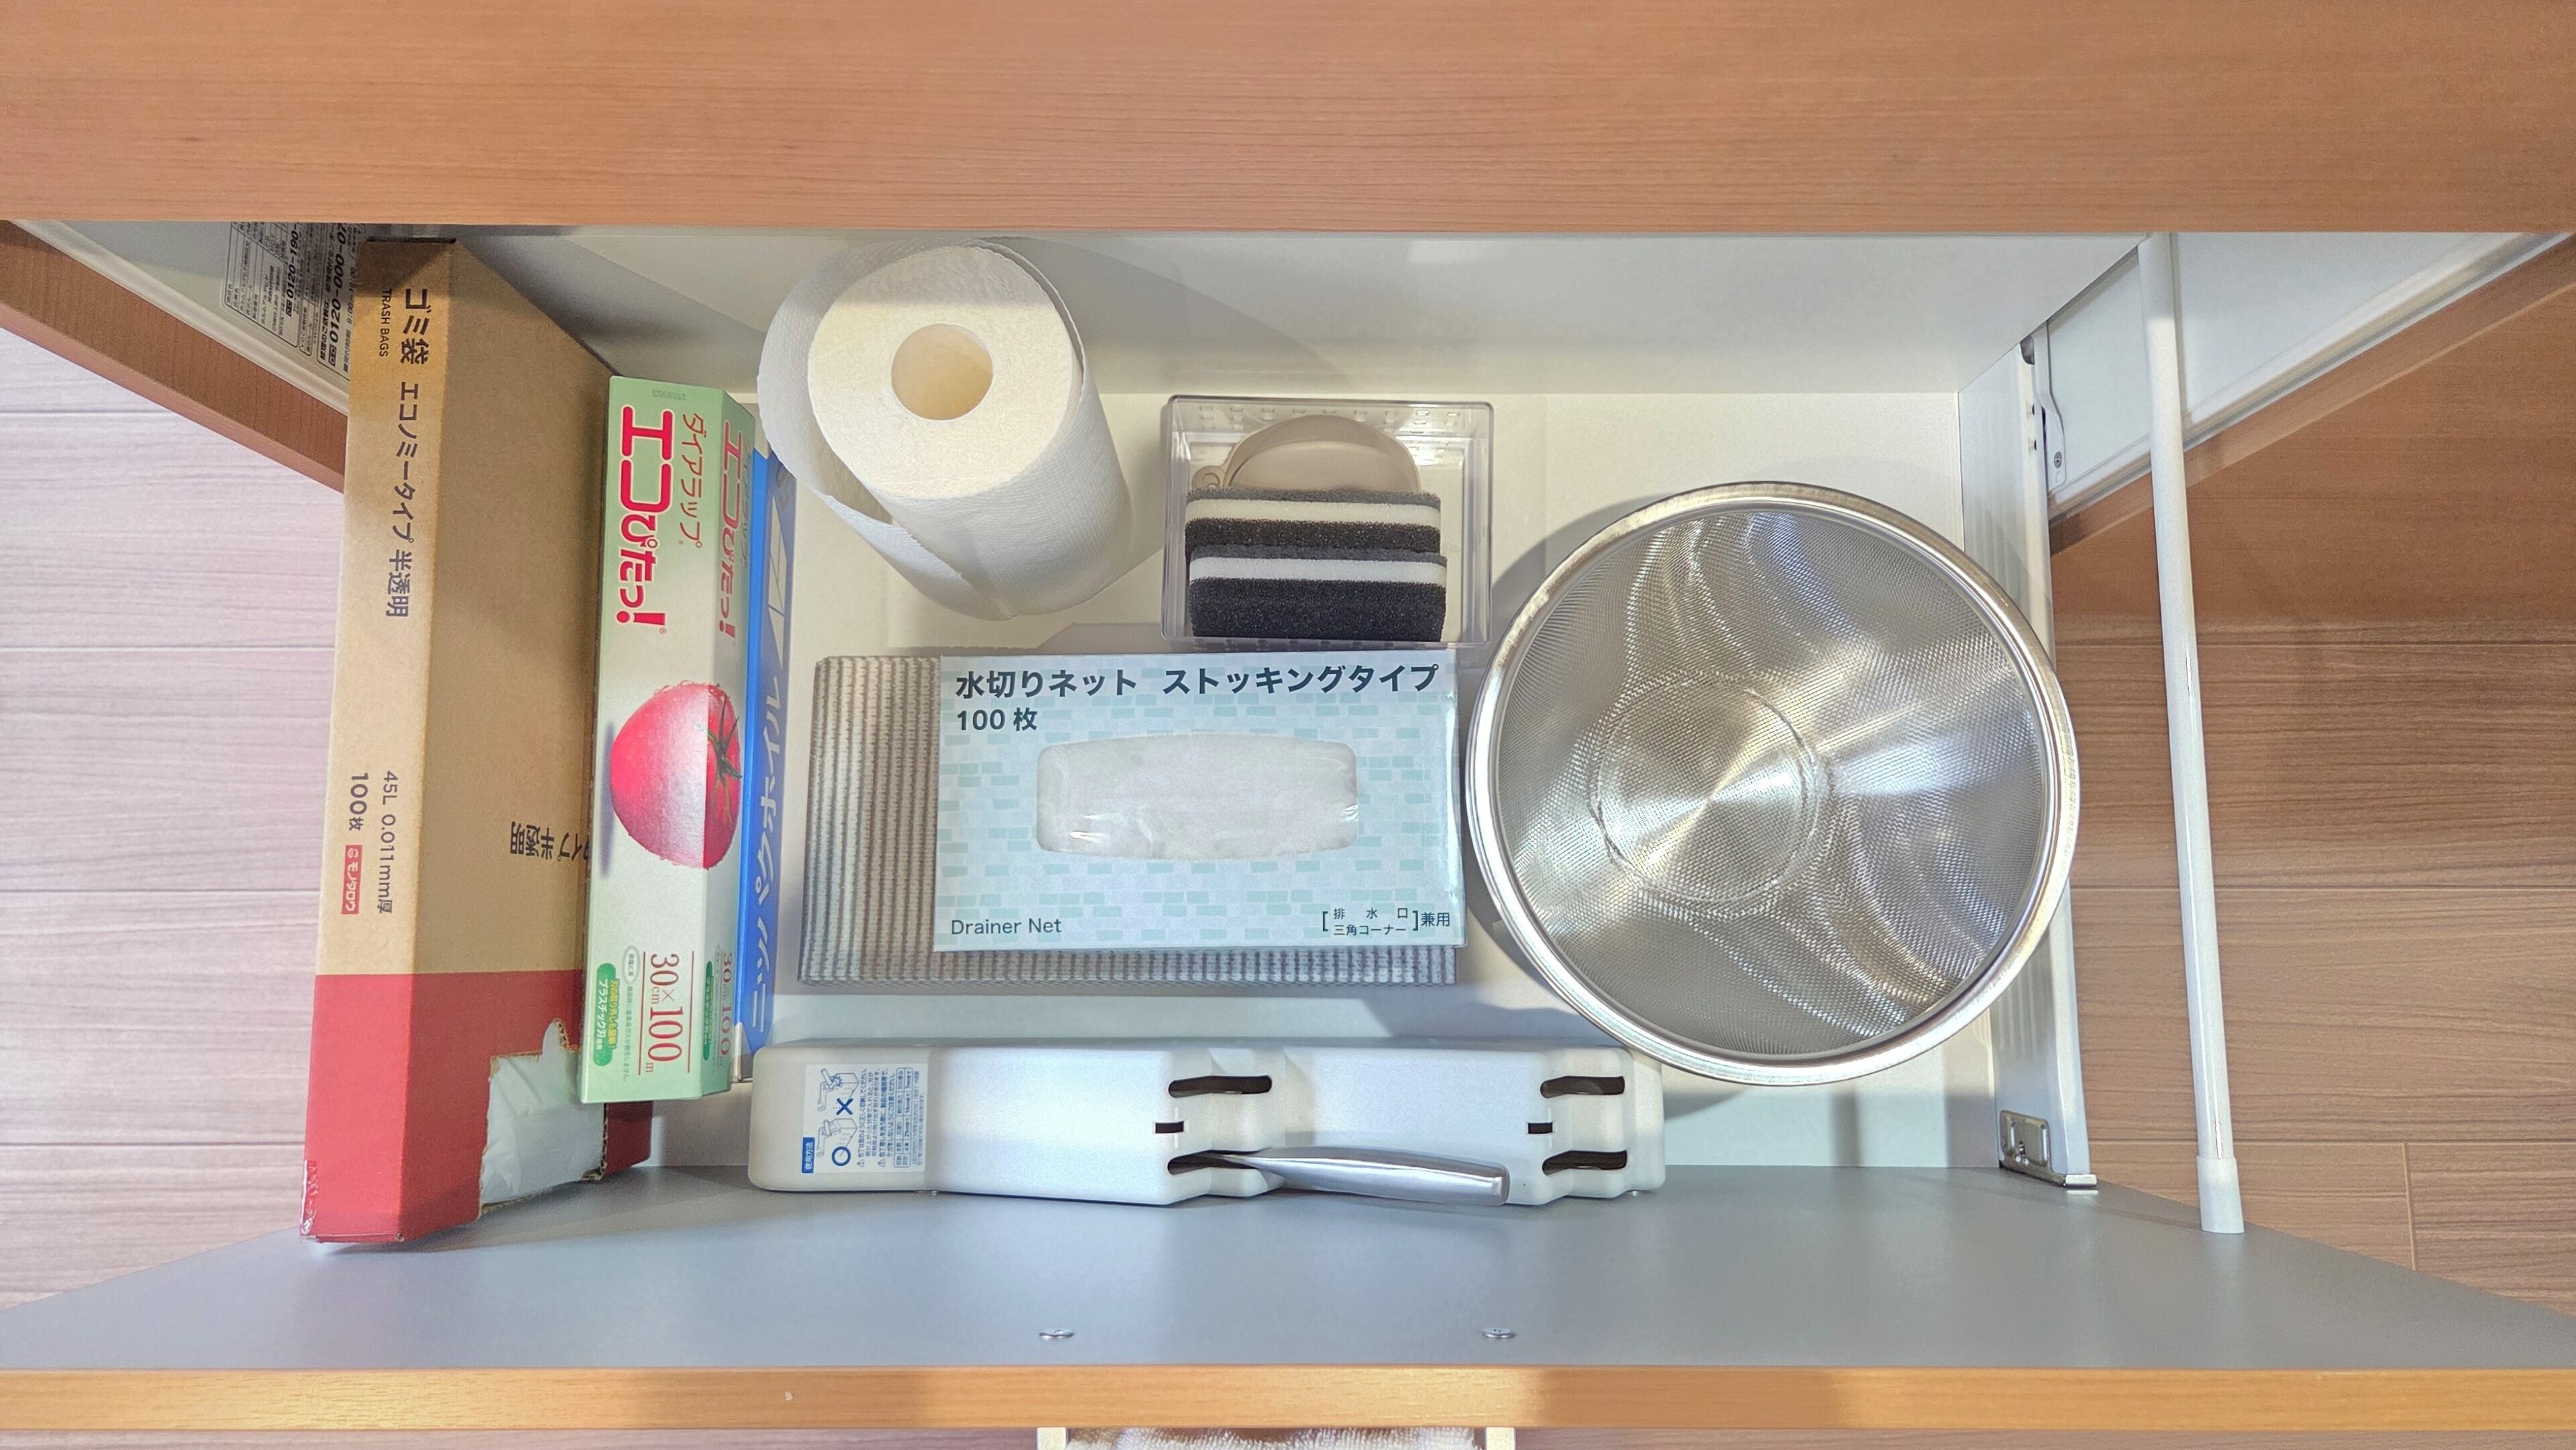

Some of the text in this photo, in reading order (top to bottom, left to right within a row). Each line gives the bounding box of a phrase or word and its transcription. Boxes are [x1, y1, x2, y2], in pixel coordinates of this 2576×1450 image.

[286, 223, 299, 299] 0120-190-
[378, 287, 392, 357] TRASH BAGS
[385, 288, 430, 618] ゴミ袋 エコノミータイプ 半透明
[680, 413, 707, 548] ダイアラップ
[955, 663, 1440, 699] 水切りネット ストッキングタイプ
[957, 707, 1038, 732] 100 枚
[349, 773, 369, 831] 100枚
[377, 770, 398, 914] 45L 0.011mm厚
[751, 675, 783, 1033] ニッパクホイル
[345, 862, 358, 912] モノタロウ
[951, 917, 1062, 935] Drainer Net
[1333, 923, 1407, 936] 三角コーナー
